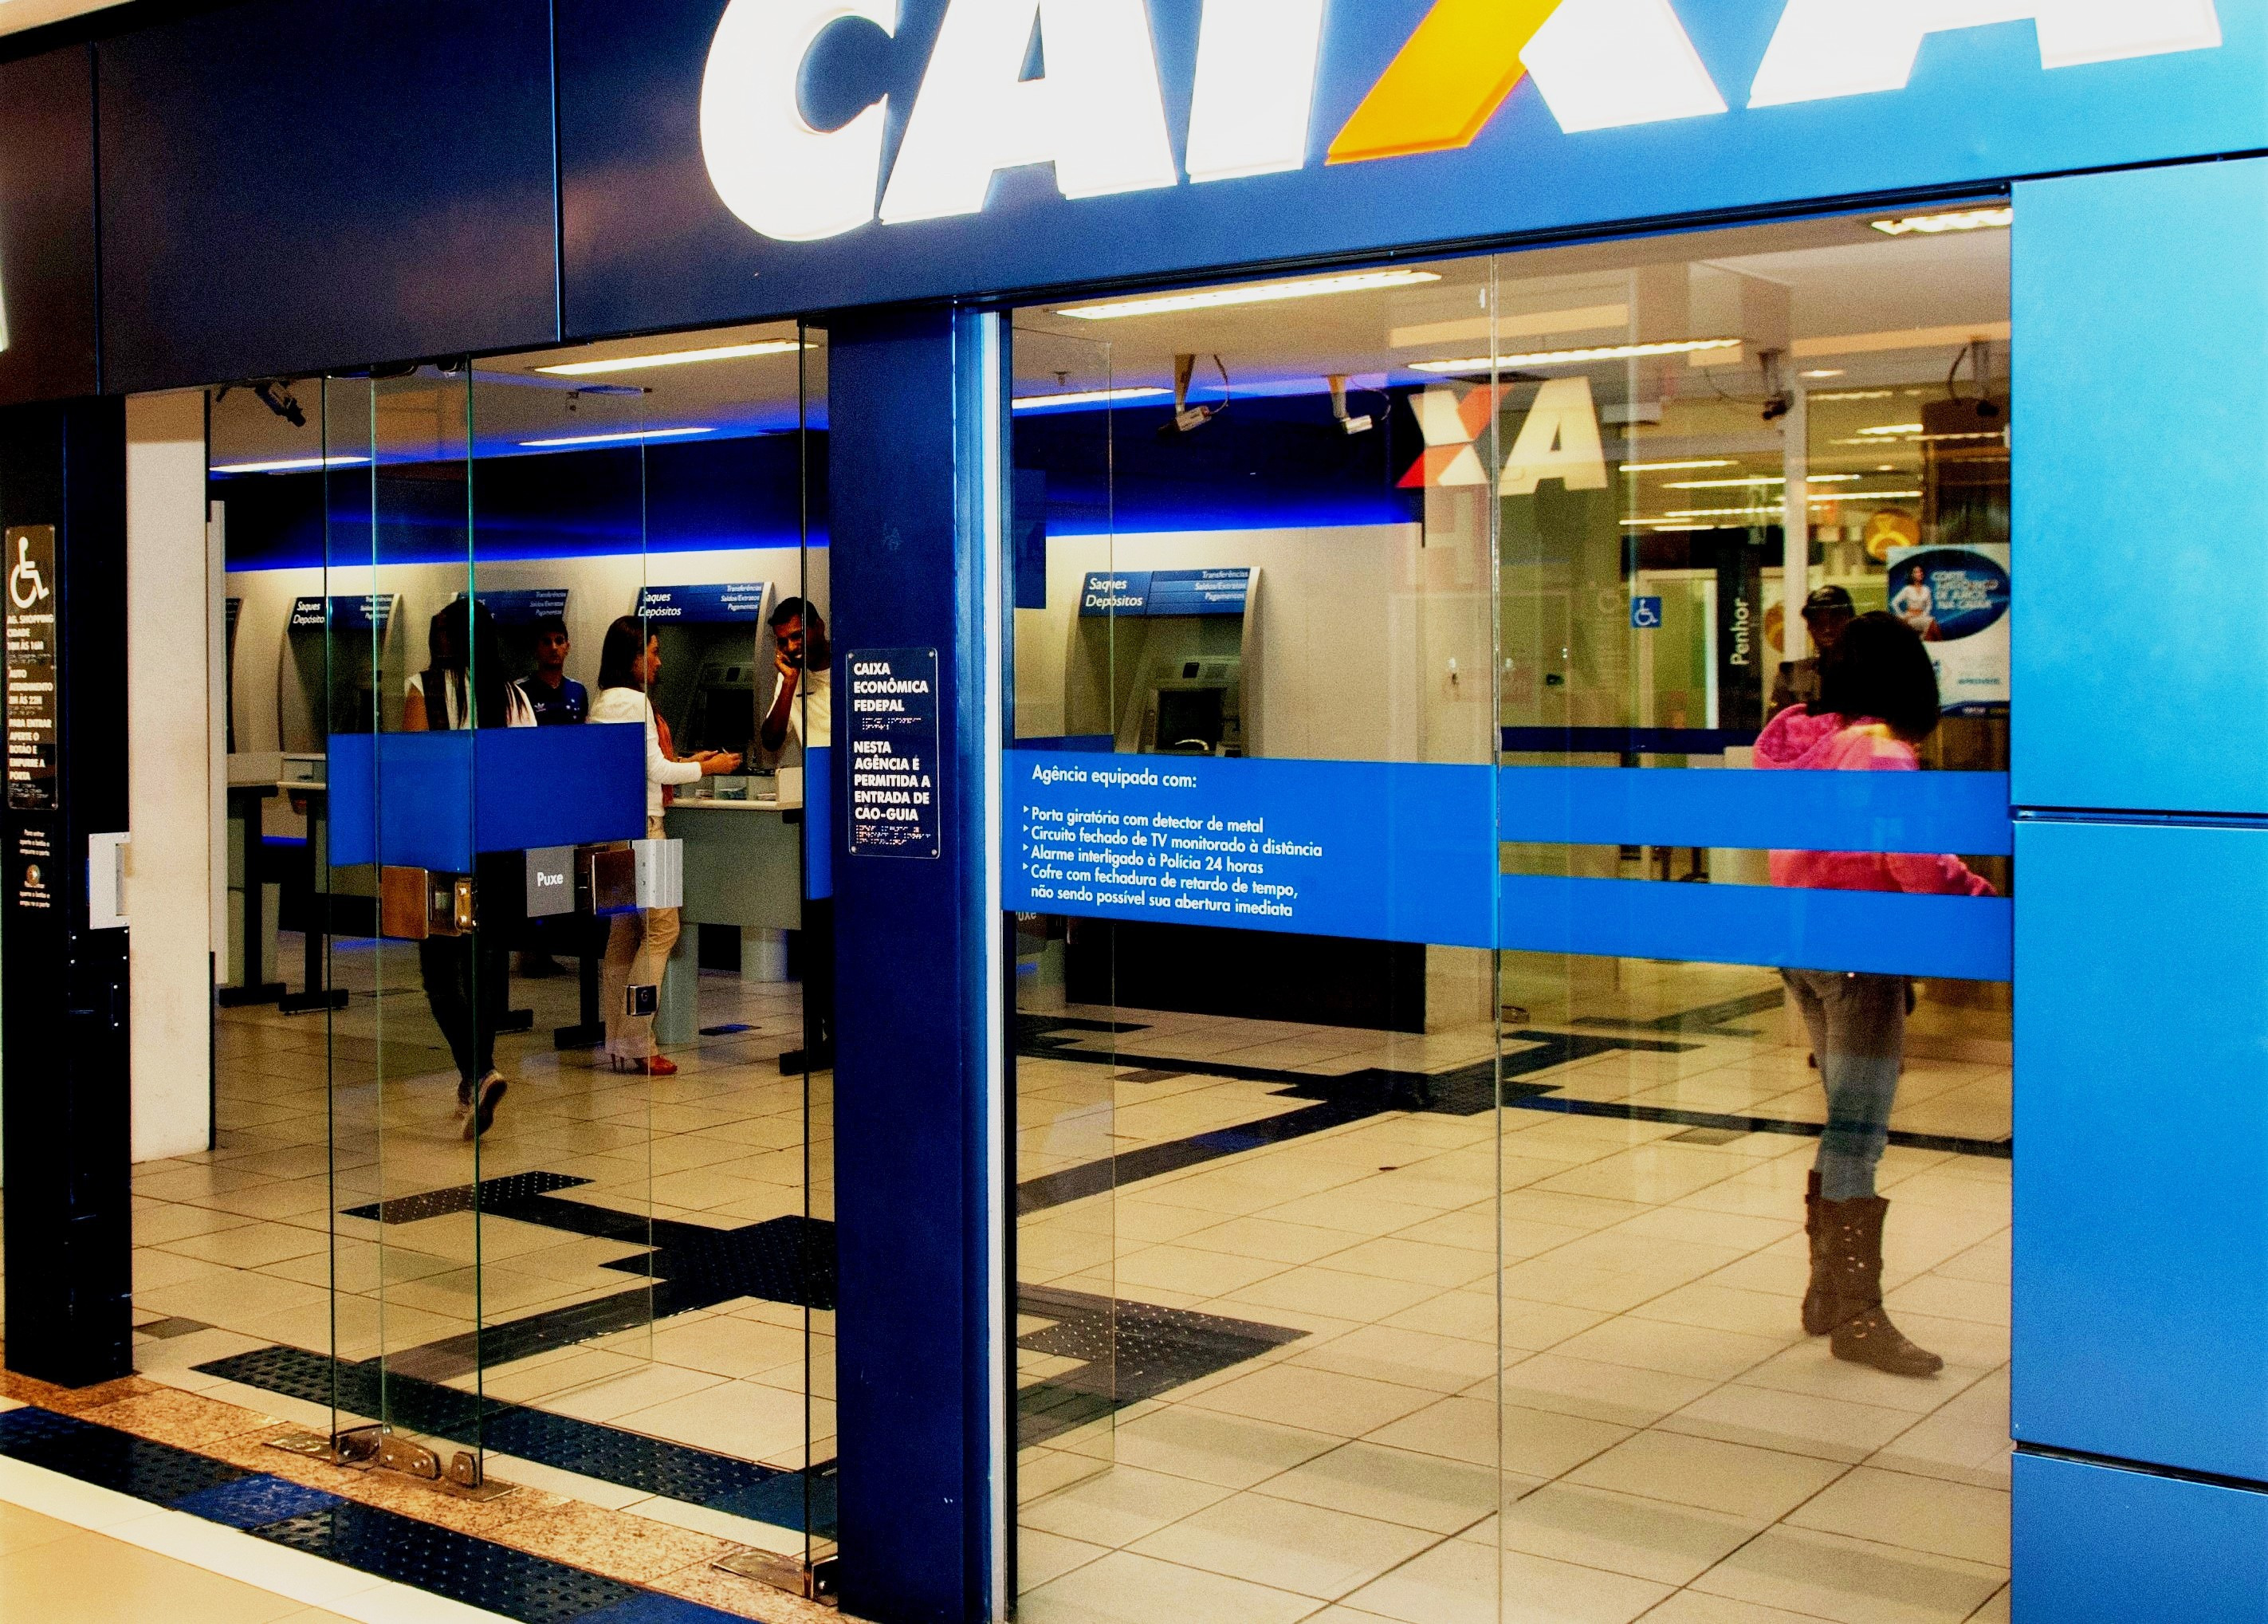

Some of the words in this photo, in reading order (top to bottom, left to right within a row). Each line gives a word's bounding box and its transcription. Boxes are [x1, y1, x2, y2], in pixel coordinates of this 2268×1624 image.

[1089, 577, 1127, 593] Saques
[297, 601, 320, 613] Saques
[1085, 594, 1143, 610] Depósitos
[293, 614, 326, 626] Depósito
[1729, 598, 1750, 666] Penhor
[853, 663, 891, 676] CAIXA
[853, 677, 930, 694] ECONÔMICA
[854, 698, 906, 713] FEDERAL
[853, 741, 892, 754] NESTA
[39, 758, 46, 769] A
[854, 754, 910, 771] AGÊNCIA
[912, 755, 920, 771] É
[854, 773, 918, 788] PERMITIDA
[921, 775, 931, 788] A
[1032, 764, 1087, 785] Agência
[1091, 767, 1158, 789] equipada
[1162, 773, 1197, 788] com:
[854, 790, 911, 805] ENTRADA
[913, 792, 930, 805] DE
[1032, 806, 1063, 822] Porta
[1067, 808, 1120, 827] giratória
[1122, 815, 1149, 827] com
[1152, 812, 1204, 830] detector
[1206, 815, 1224, 832] de
[1227, 816, 1264, 834] metal
[1031, 825, 1076, 842] Circuito
[1079, 827, 1128, 845] fechado
[1131, 830, 1148, 846] de
[1150, 832, 1168, 847] TV
[1171, 835, 1246, 854] monitorado
[1249, 838, 1259, 853] à
[1262, 837, 1323, 857] distância
[1030, 843, 1075, 862] Alarme
[1078, 847, 1145, 869] interligado
[1147, 852, 1156, 867] à
[1160, 852, 1201, 871] Polícia
[1205, 855, 1224, 871] 24
[1226, 855, 1264, 875] horas
[537, 871, 564, 887] Puxe
[1031, 863, 1063, 879] Cofre
[1066, 870, 1091, 883] com
[1095, 867, 1158, 887] fechadura
[1160, 871, 1177, 888] de
[1180, 875, 1228, 892] retardo
[1231, 876, 1249, 894] de
[1252, 880, 1299, 900] tempo,
[1031, 884, 1055, 899] não
[1057, 886, 1094, 902] sendo
[1096, 889, 1146, 907] possível
[1148, 895, 1172, 908] sua
[1174, 893, 1232, 912] abertura
[1235, 898, 1294, 918] imediata
